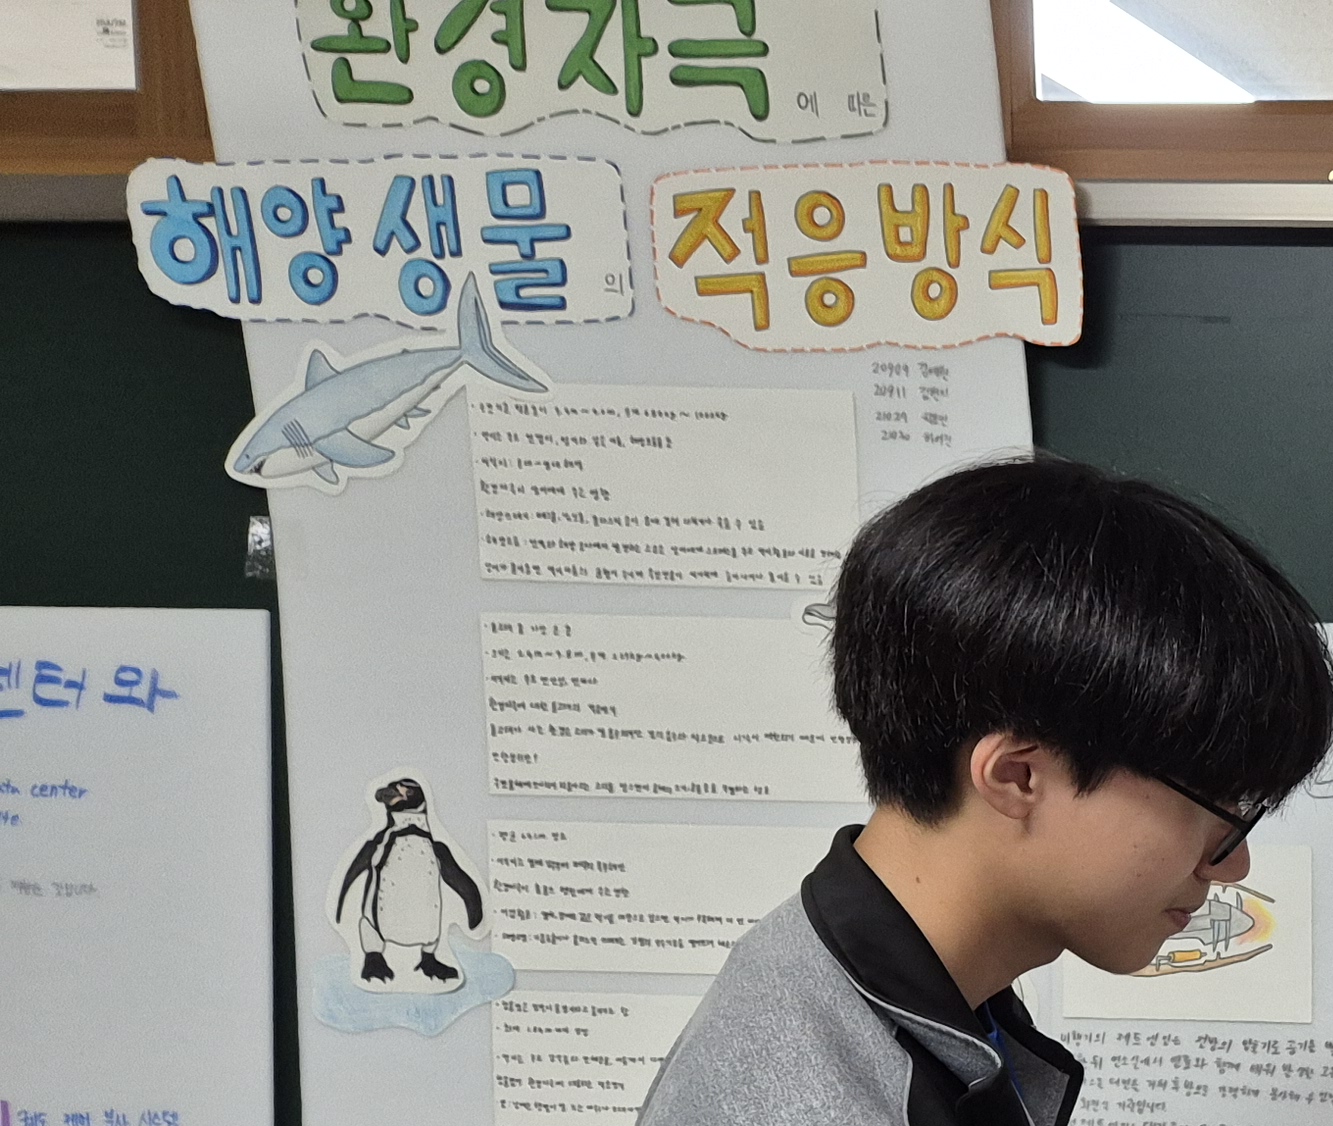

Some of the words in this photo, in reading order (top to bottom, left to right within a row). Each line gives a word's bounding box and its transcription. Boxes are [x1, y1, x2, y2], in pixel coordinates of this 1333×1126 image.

[797, 91, 819, 118] 에
[848, 92, 879, 118] 따른
[141, 174, 352, 306] 해양
[373, 168, 571, 316] 생물
[603, 272, 625, 298] 의
[103, 665, 180, 714] 와
